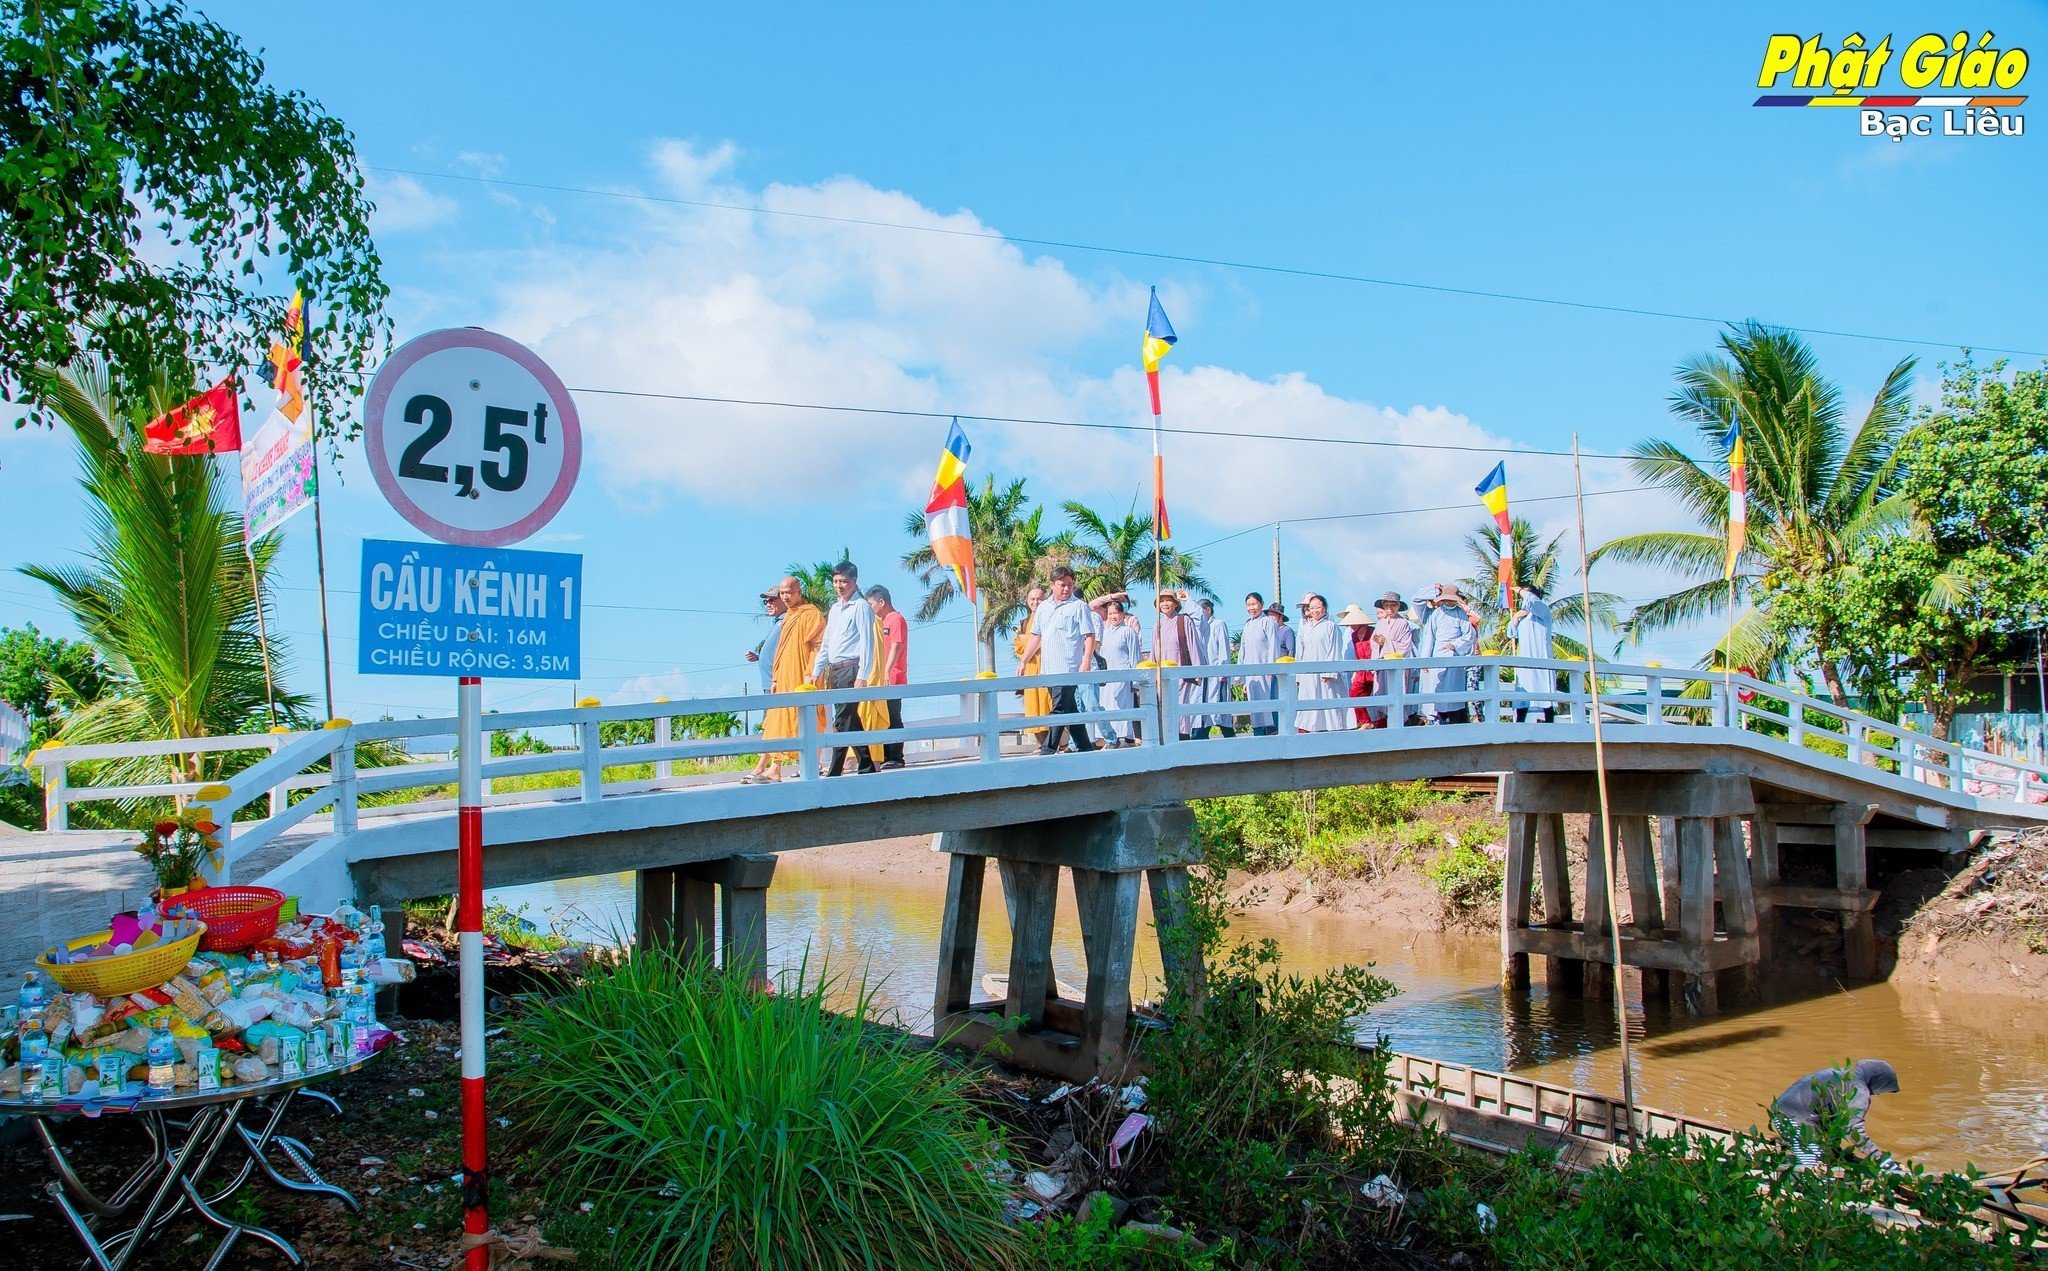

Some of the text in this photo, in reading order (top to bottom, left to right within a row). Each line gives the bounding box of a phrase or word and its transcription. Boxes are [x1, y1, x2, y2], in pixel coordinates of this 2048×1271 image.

[370, 550, 574, 620] CẦU KÊNH 1
[378, 618, 547, 646] CHIỀU DÀI: 16M
[370, 643, 570, 672] CHIỀU RỘNG: 3,5M
